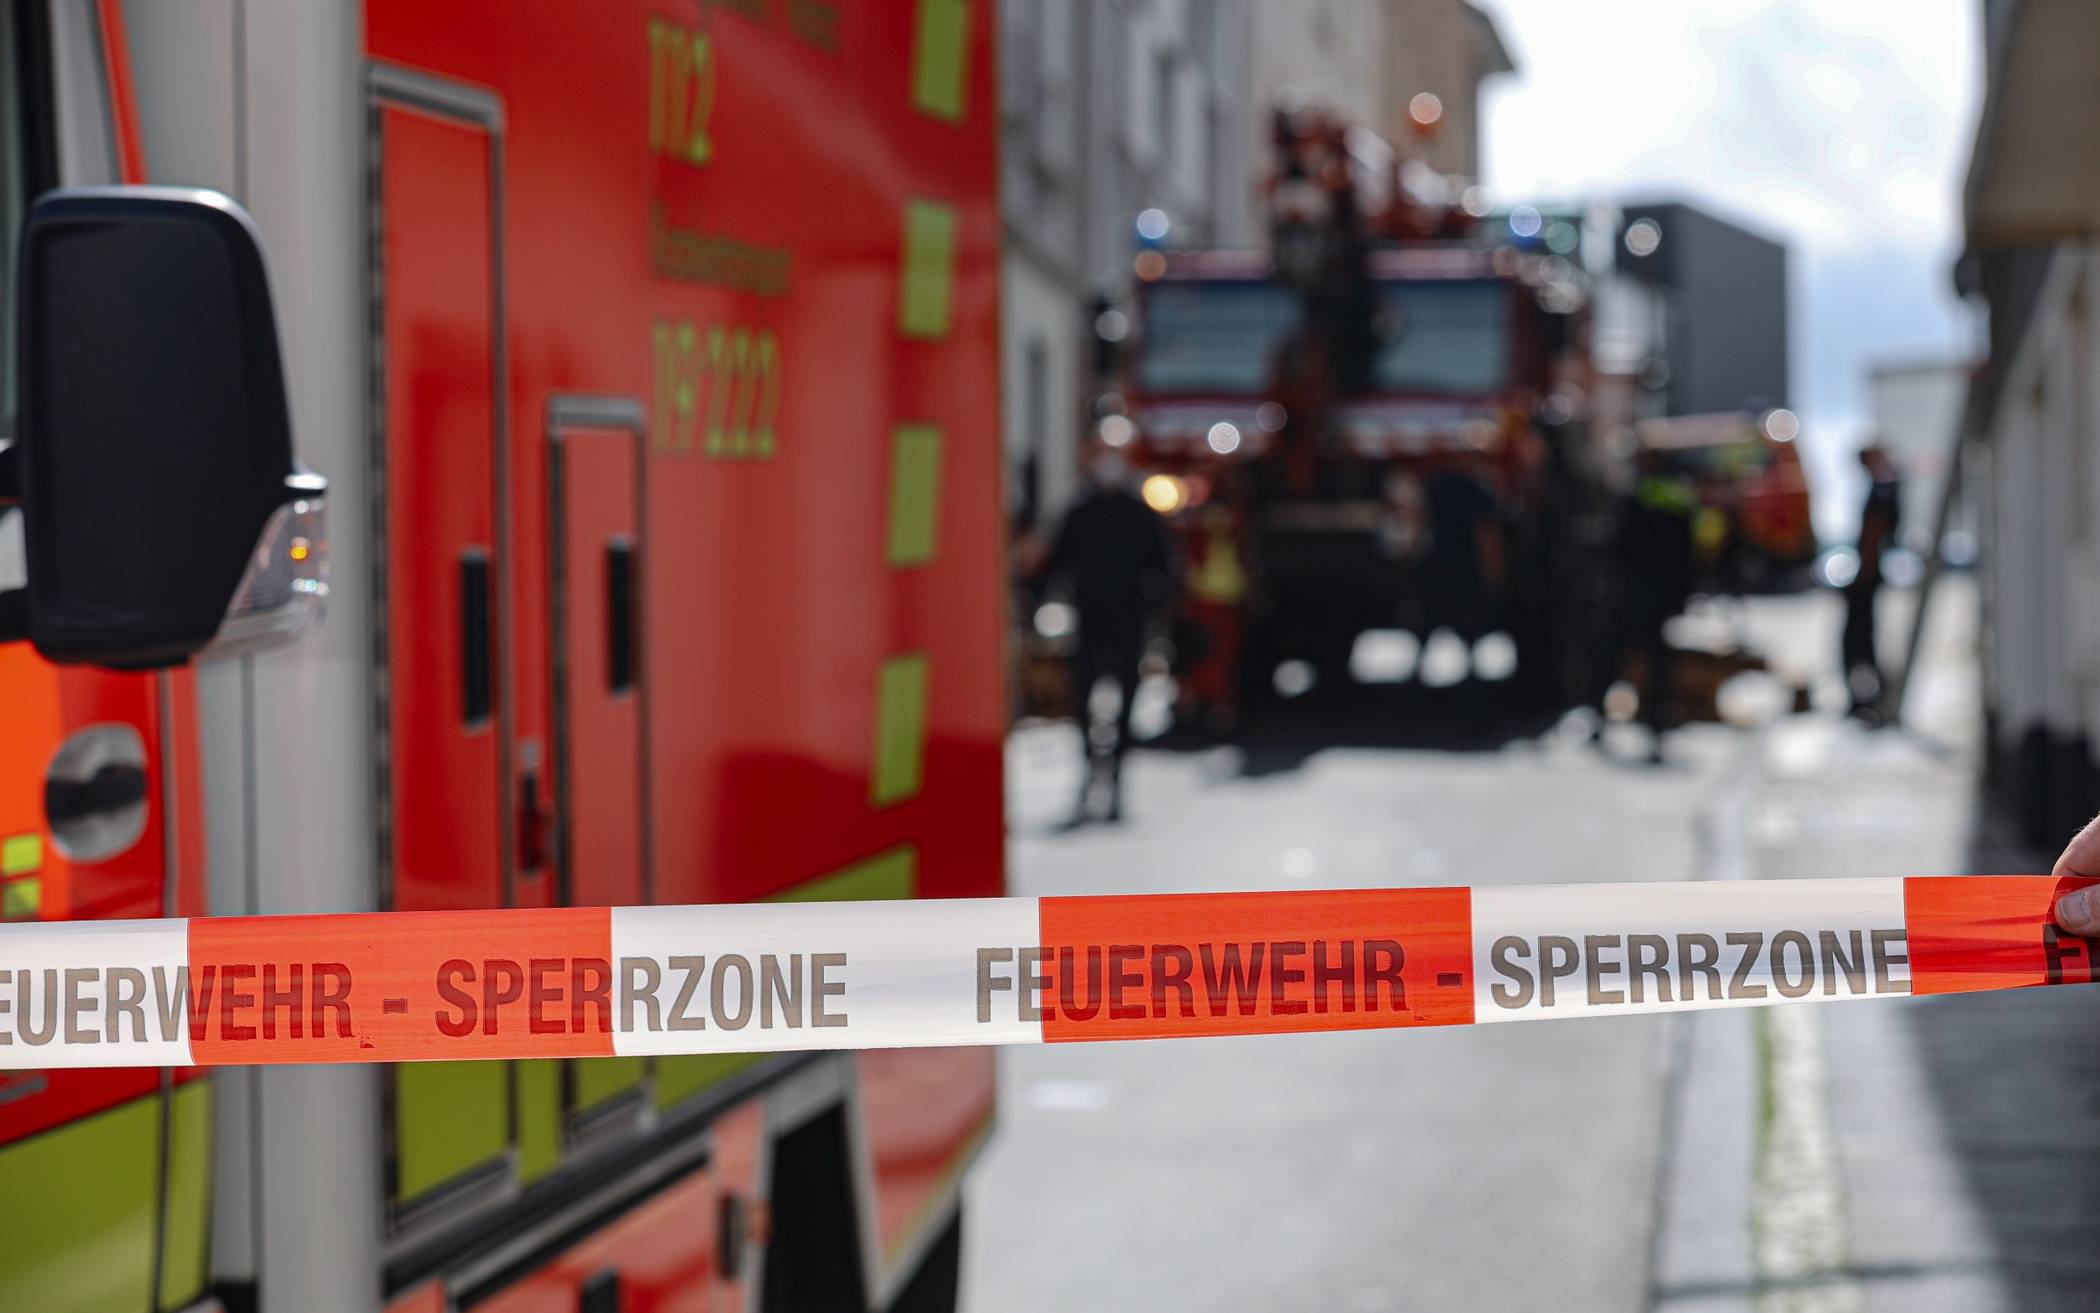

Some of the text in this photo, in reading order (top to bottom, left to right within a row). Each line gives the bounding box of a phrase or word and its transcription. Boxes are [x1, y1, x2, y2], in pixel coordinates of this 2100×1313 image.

[650, 19, 716, 168] 112
[705, 326, 779, 460] 222
[435, 952, 849, 1038] SPERRZONE
[976, 939, 1409, 1023] FEUERWEHR
[1490, 928, 1912, 1010] SPERRZONE
